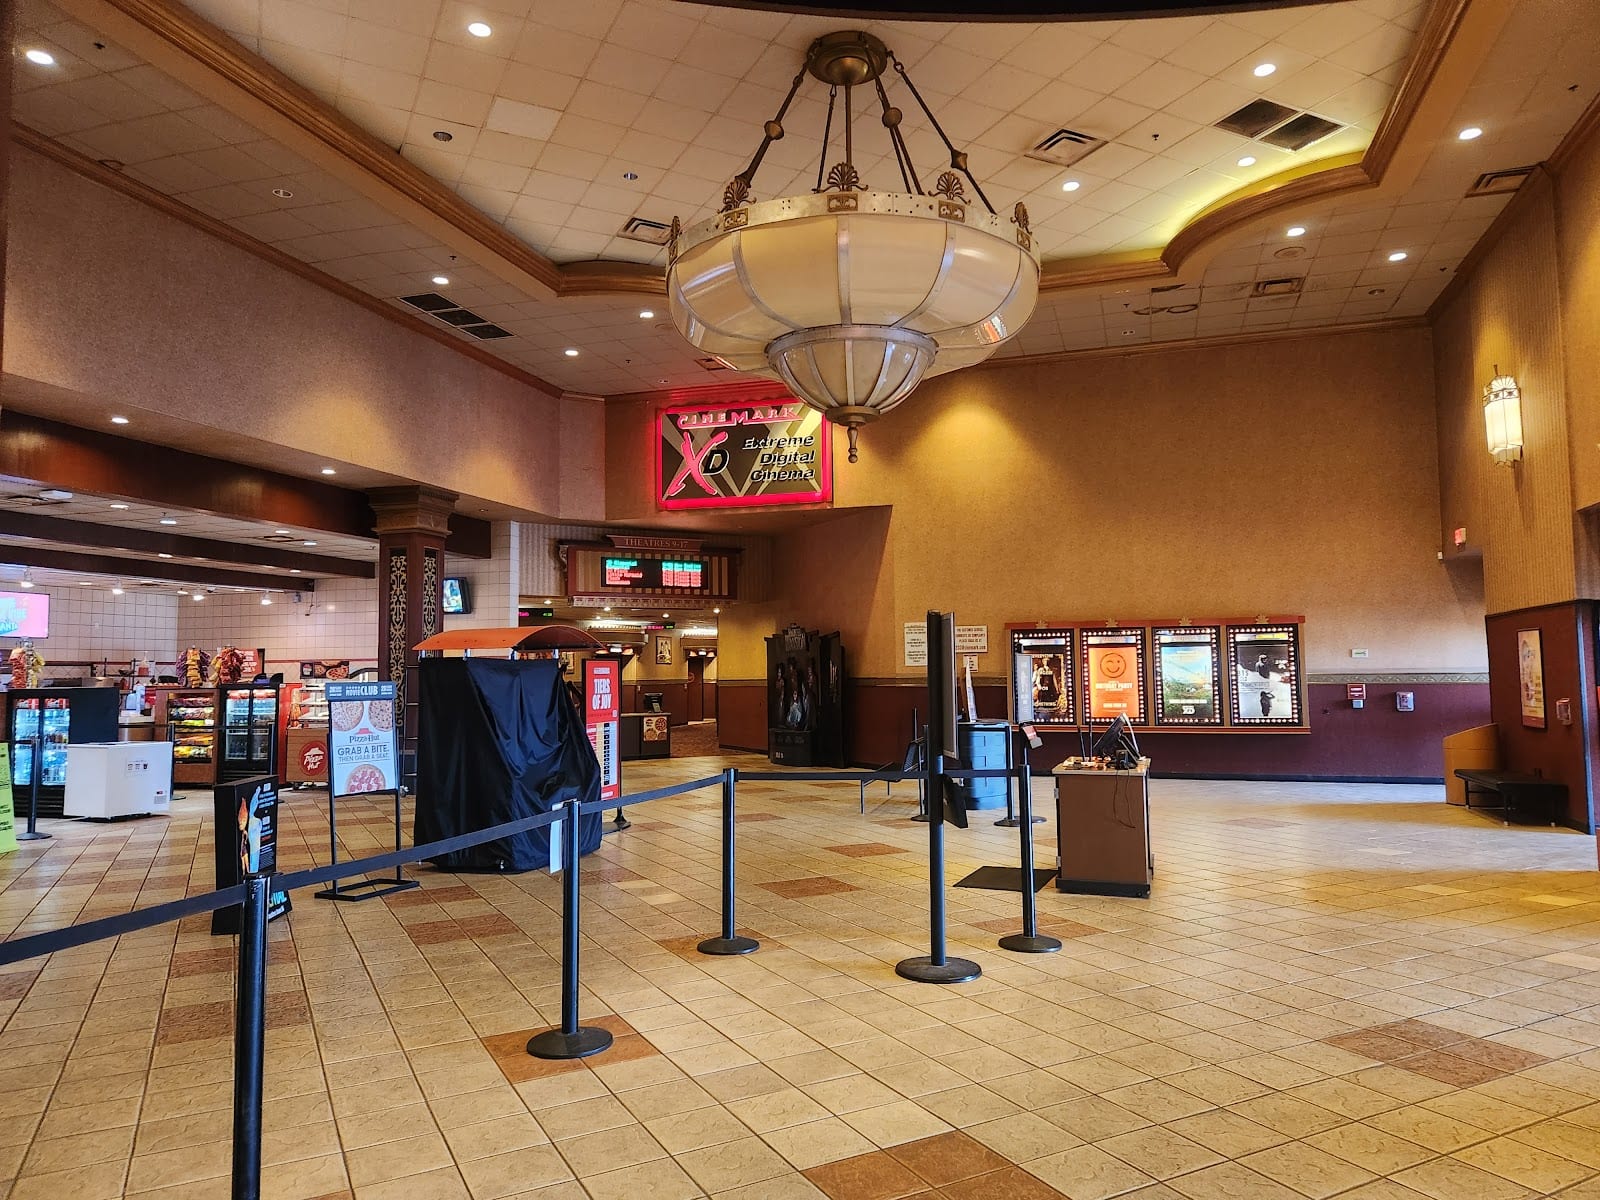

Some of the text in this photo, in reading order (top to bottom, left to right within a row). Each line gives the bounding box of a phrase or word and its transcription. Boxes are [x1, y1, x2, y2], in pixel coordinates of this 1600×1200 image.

[677, 407, 802, 430] CINEMARK
[742, 434, 814, 450] Extreme
[760, 450, 815, 467] Digital
[750, 467, 815, 483] Cinema
[625, 538, 670, 548] THEATRES
[360, 685, 378, 696] CLUB
[594, 678, 611, 694] TIERS
[349, 735, 368, 743] Pizza
[337, 746, 362, 756] GRAB
[363, 745, 370, 754] A
[303, 754, 324, 766] Pizza
[308, 761, 321, 771] Hut
